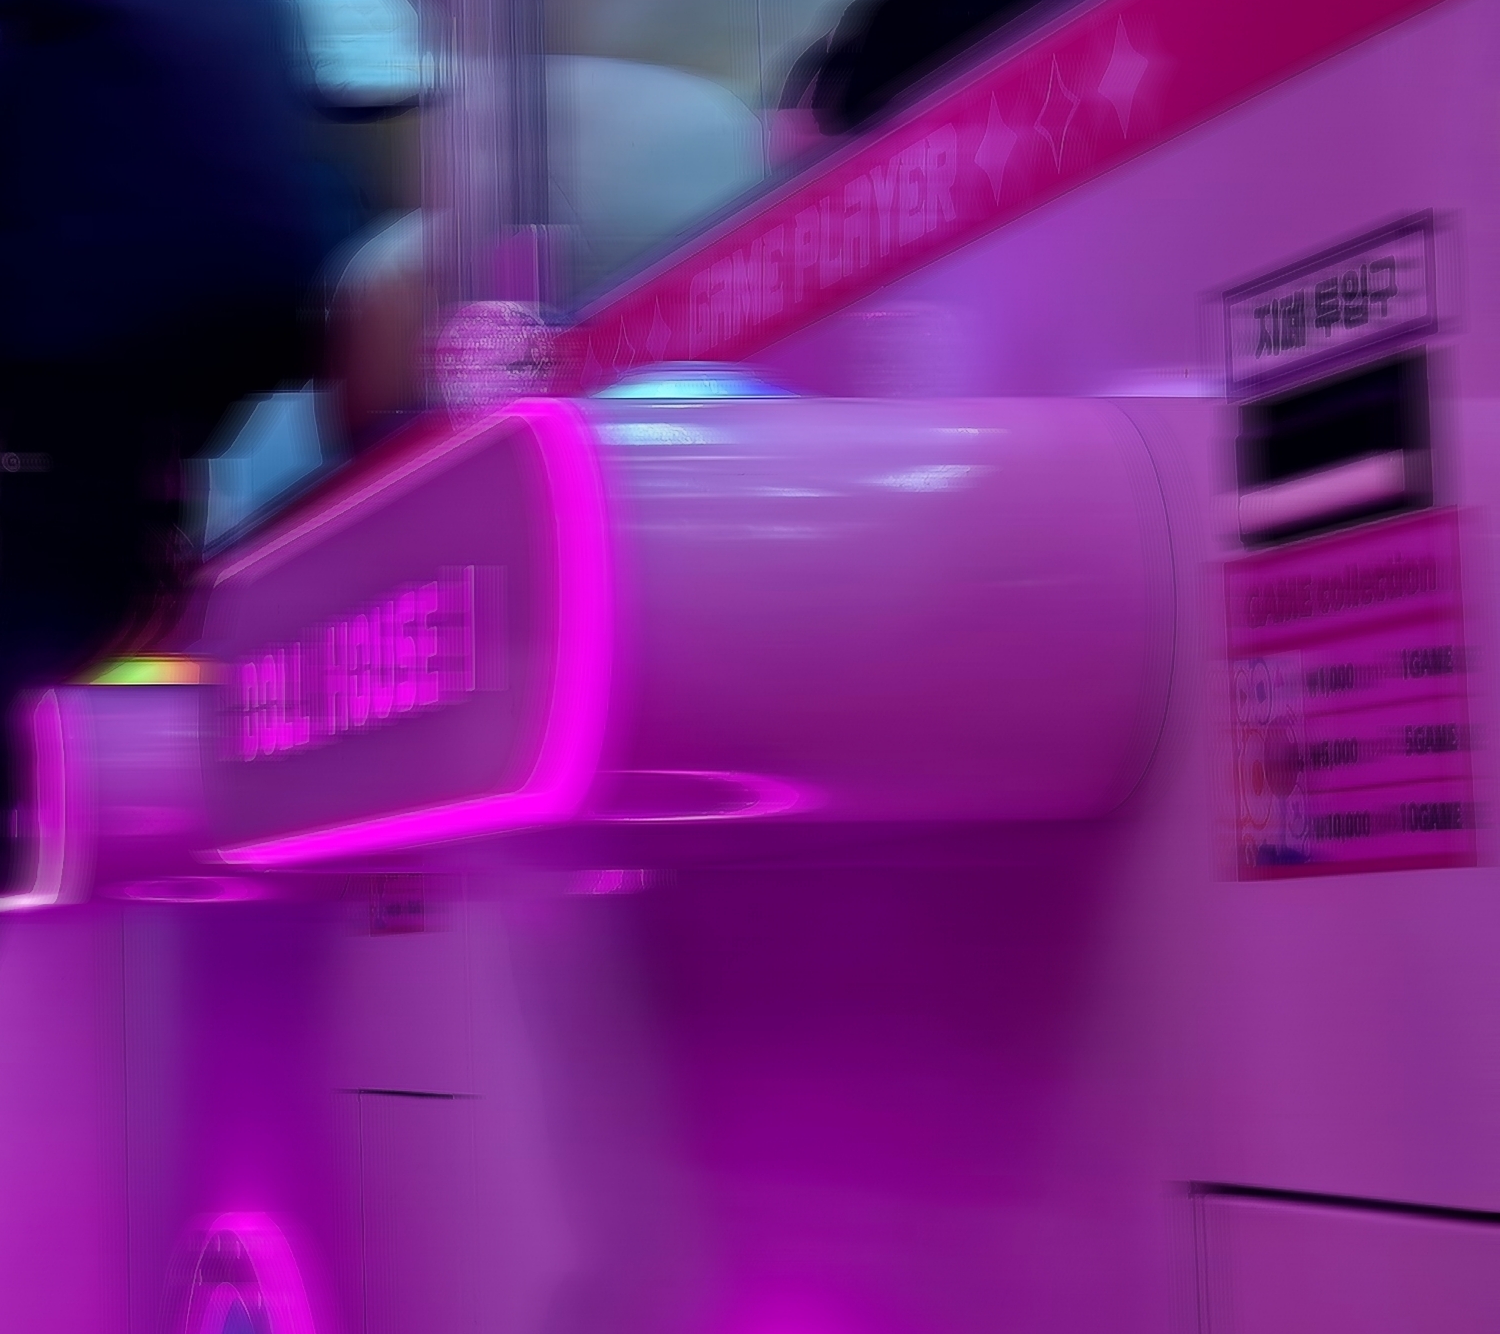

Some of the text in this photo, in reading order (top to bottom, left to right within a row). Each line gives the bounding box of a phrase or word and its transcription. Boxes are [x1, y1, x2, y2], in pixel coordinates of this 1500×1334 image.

[689, 122, 957, 359] GAME PLAYER
[1253, 255, 1398, 359] 지폐 투입구
[326, 579, 441, 737] HOUSE
[1249, 575, 1313, 630] GAME
